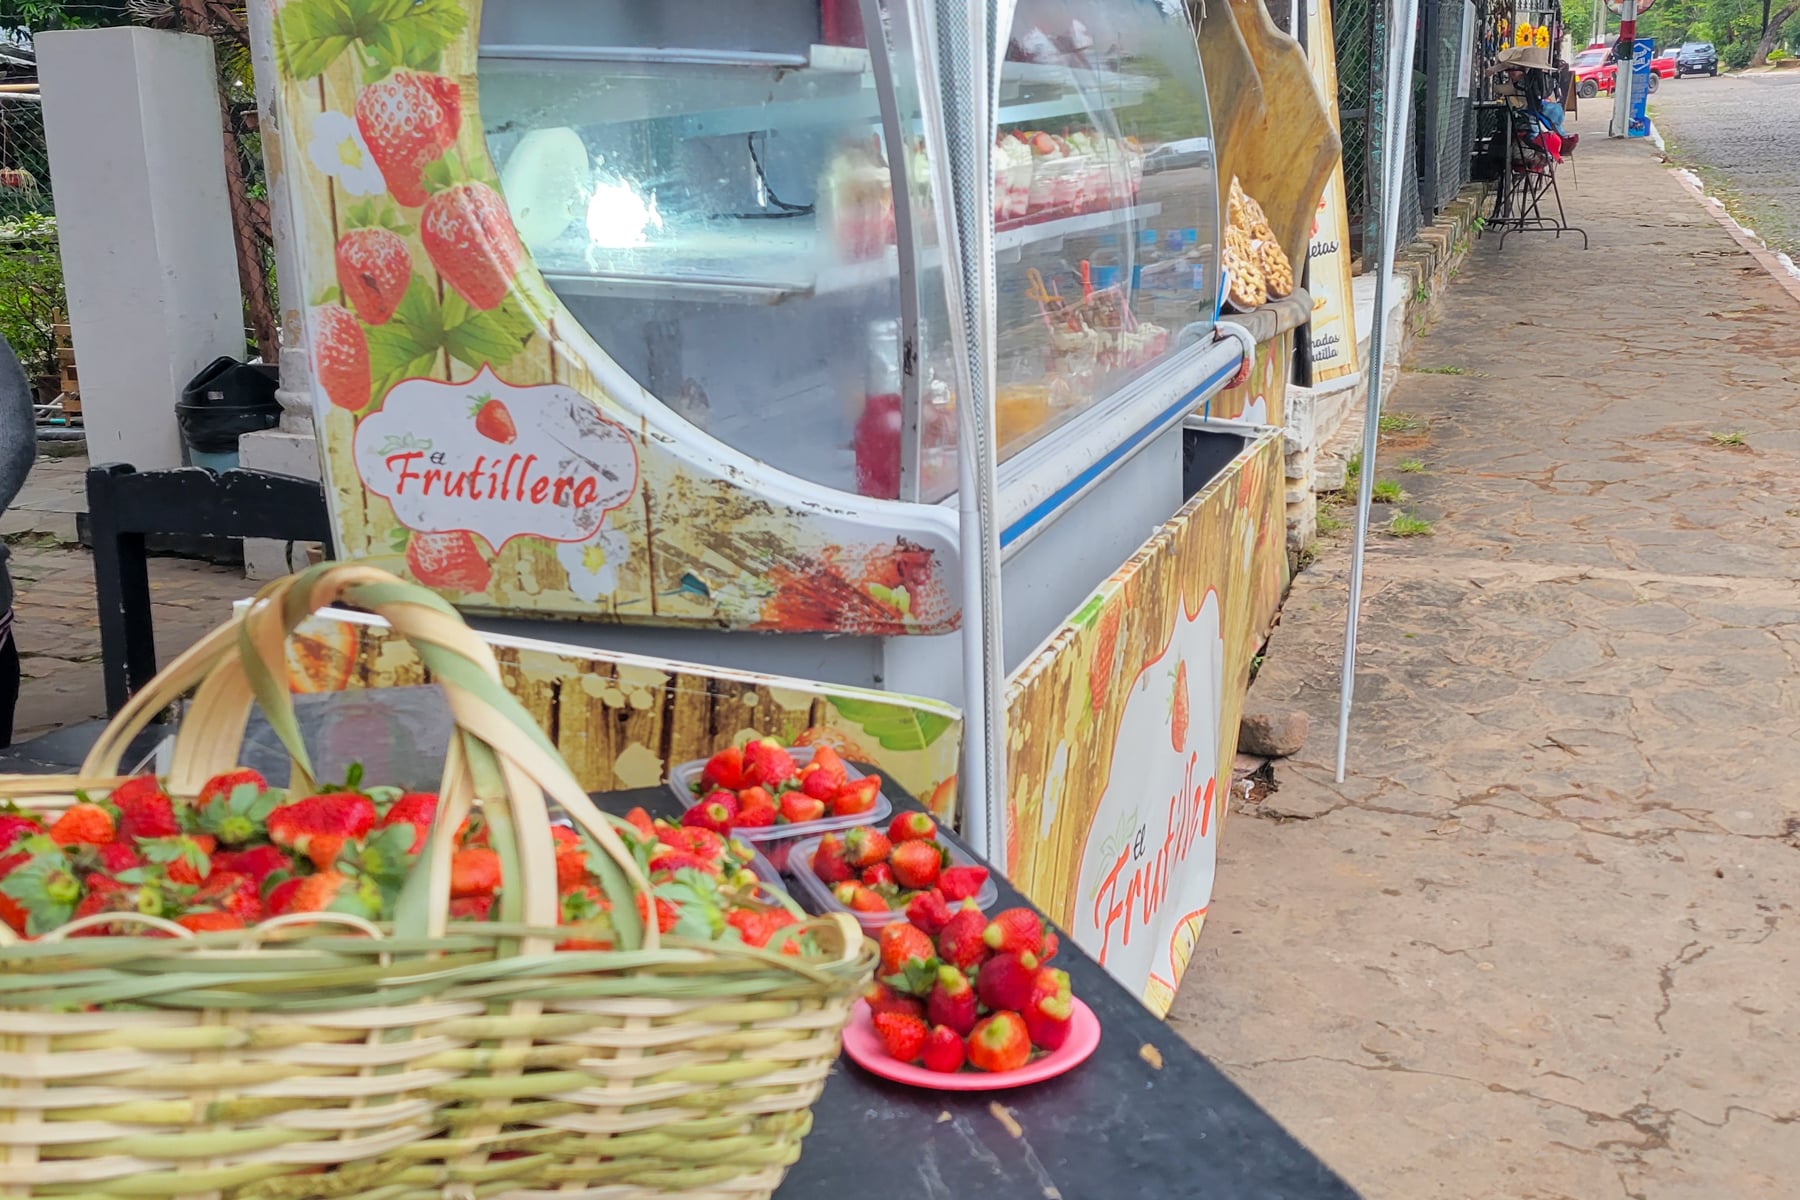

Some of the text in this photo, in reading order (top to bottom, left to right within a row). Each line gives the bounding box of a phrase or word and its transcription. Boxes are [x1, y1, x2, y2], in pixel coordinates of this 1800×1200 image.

[1309, 240, 1339, 257] etas
[385, 450, 598, 509] Frutillero
[1094, 751, 1216, 967] Frutiller
[1133, 823, 1147, 861] El
